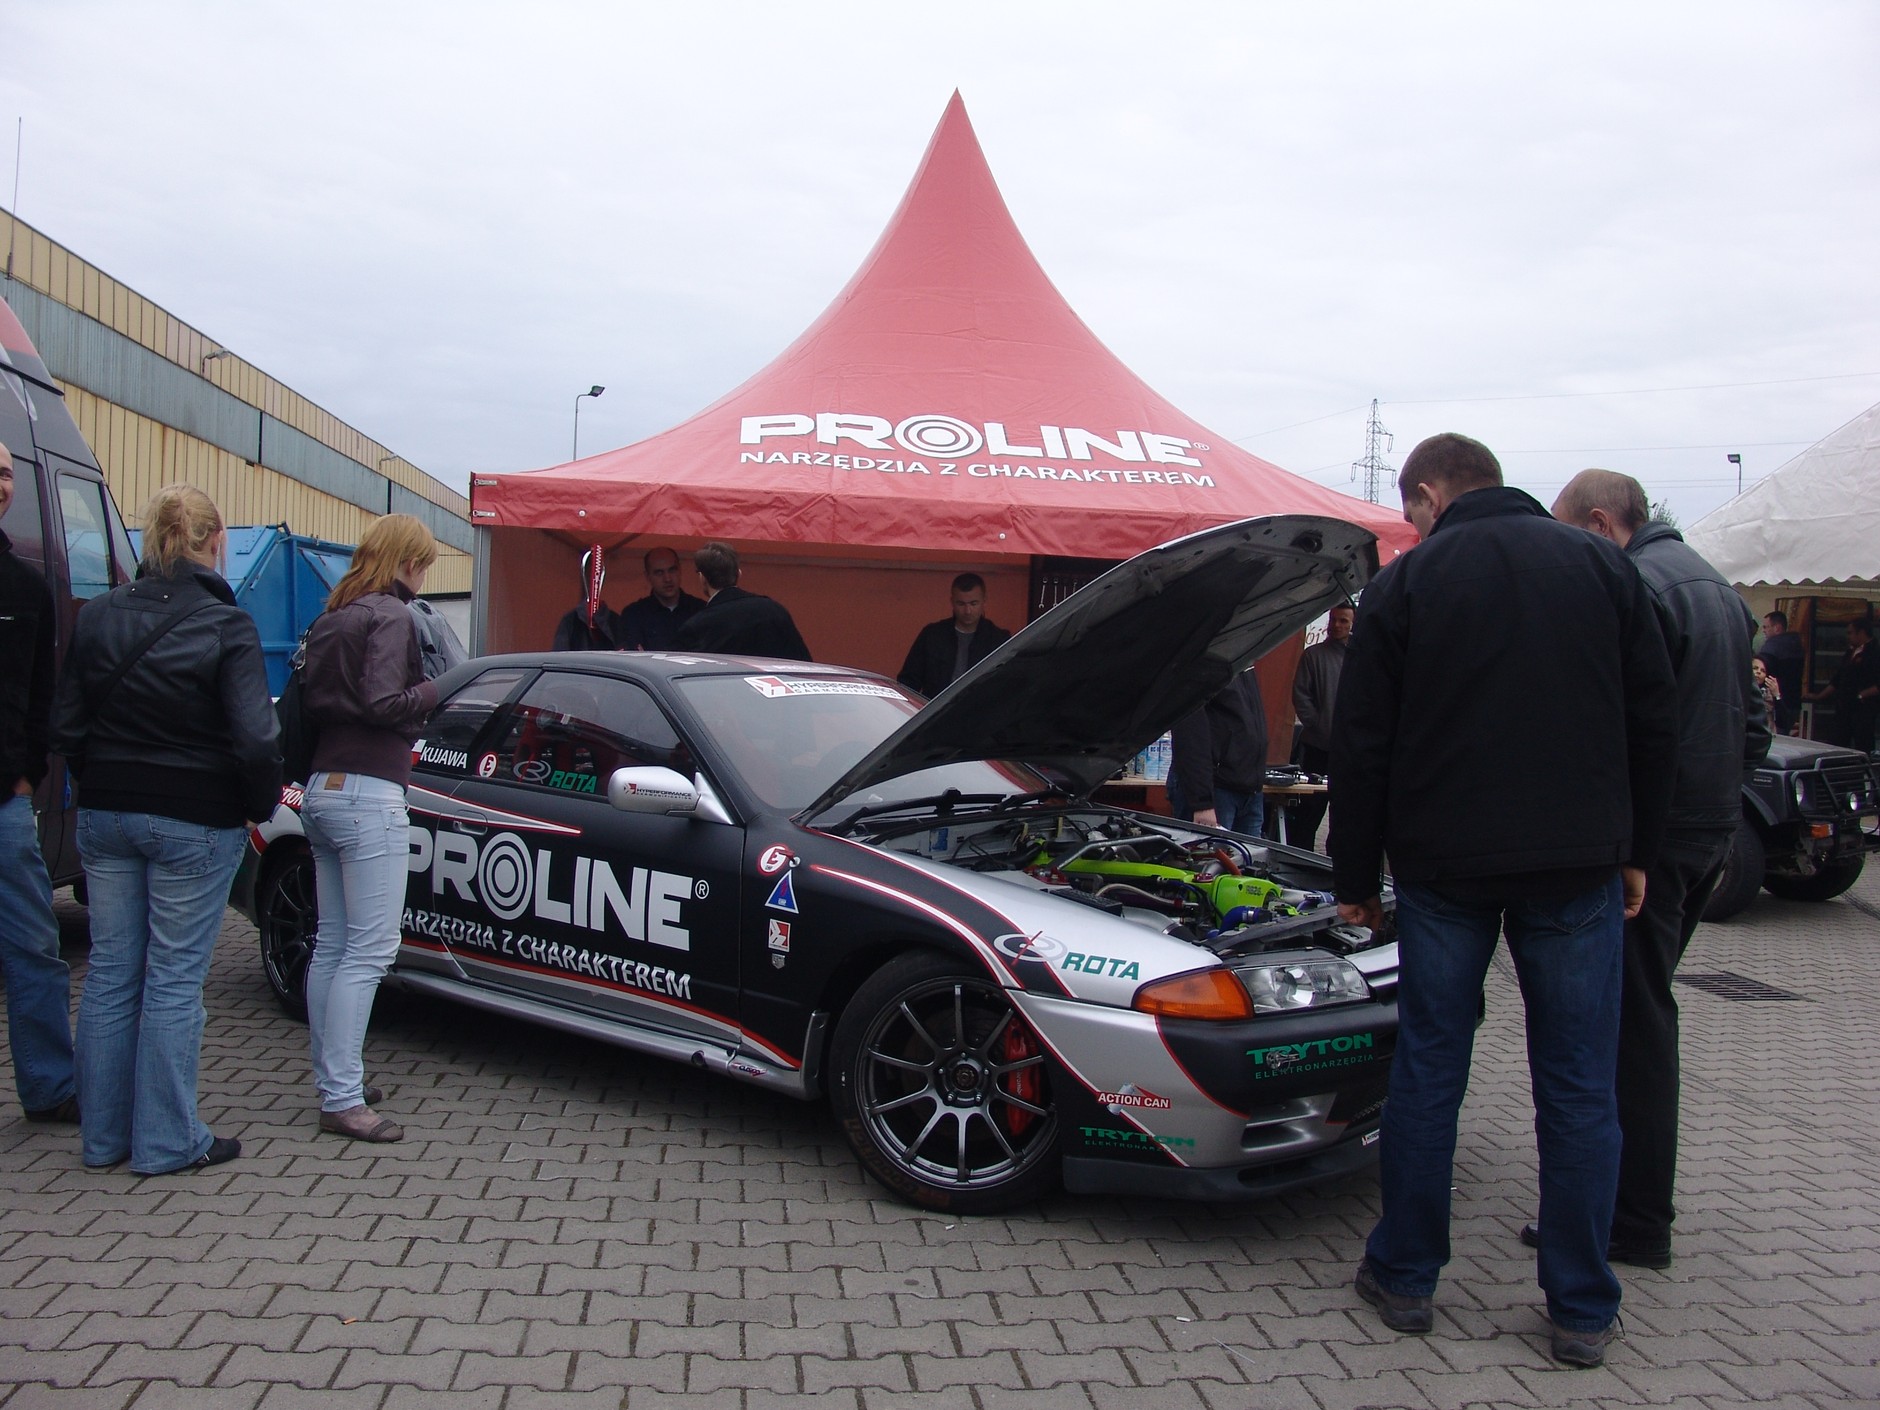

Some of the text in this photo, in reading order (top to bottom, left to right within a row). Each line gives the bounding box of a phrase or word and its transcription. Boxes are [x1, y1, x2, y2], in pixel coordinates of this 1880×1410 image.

[740, 450, 1216, 487] NARZĘDZIA Z CHARAKTEREM
[420, 746, 468, 769] KUJAWA
[549, 770, 597, 793] ROTA
[400, 907, 693, 1000] ARZĘDZIA Z CHARAKTEREM
[1061, 951, 1140, 980] ROTA
[1098, 1093, 1169, 1108] ACTION CAN
[1080, 1127, 1195, 1147] TRYTON
